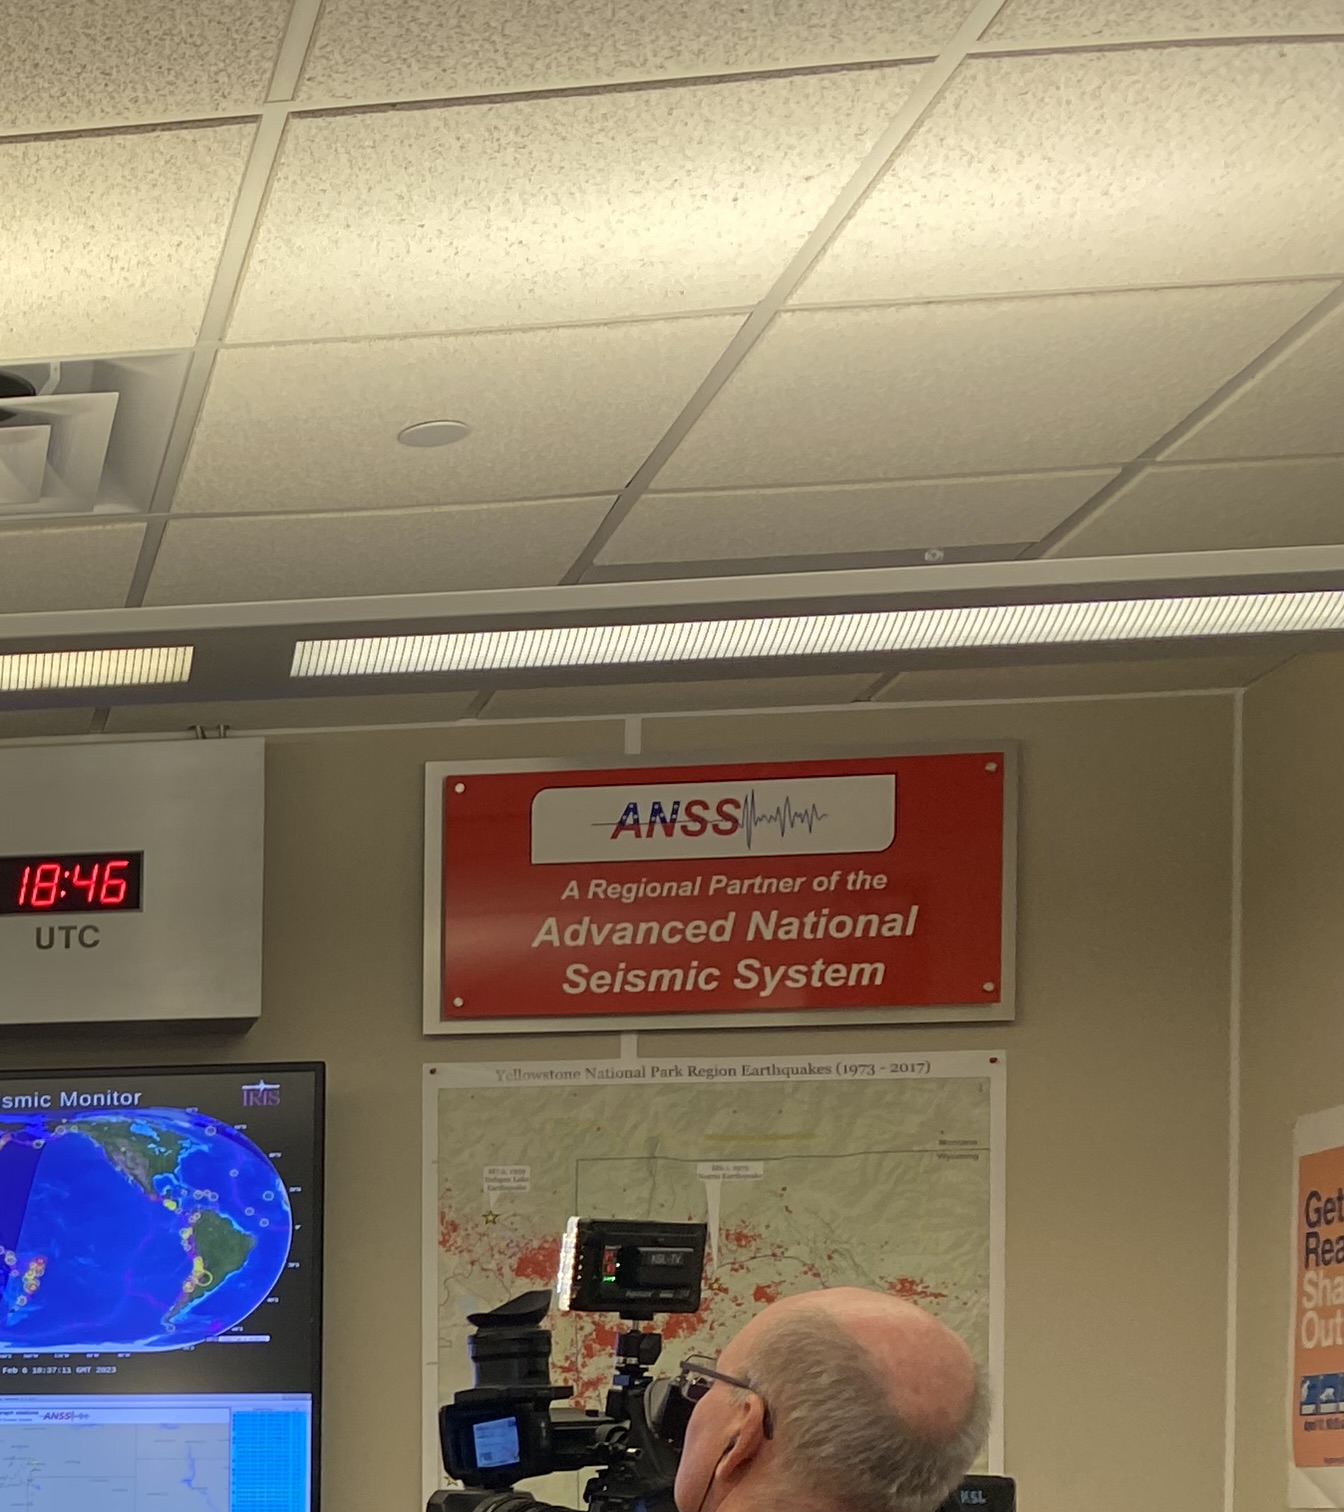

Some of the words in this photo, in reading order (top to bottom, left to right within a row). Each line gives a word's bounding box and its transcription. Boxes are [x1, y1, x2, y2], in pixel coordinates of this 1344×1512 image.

[610, 797, 742, 840] ANSS
[16, 859, 130, 908] 18:46
[561, 879, 580, 900] A
[588, 875, 701, 903] Regional
[708, 872, 805, 895] Partner
[811, 870, 840, 892] of
[846, 868, 888, 890] the
[35, 924, 101, 950] UTC
[531, 912, 736, 948] Advanced
[745, 905, 919, 942] National
[561, 962, 720, 996] Seismic
[733, 957, 886, 996] System
[496, 1066, 581, 1083] Yellowstone
[585, 1065, 646, 1079] National
[651, 1064, 683, 1078] Park
[688, 1062, 737, 1079] Region
[741, 1062, 832, 1079] Earthquakes
[836, 1062, 875, 1076] (1973
[890, 1060, 931, 1074] 2017)
[60, 1089, 142, 1107] Monitor
[243, 1085, 281, 1107] IRIS
[1305, 1188, 1344, 1228] Get
[1301, 1310, 1344, 1349] Out
[43, 1412, 72, 1421] ANSS
[960, 1490, 986, 1504] KSL
